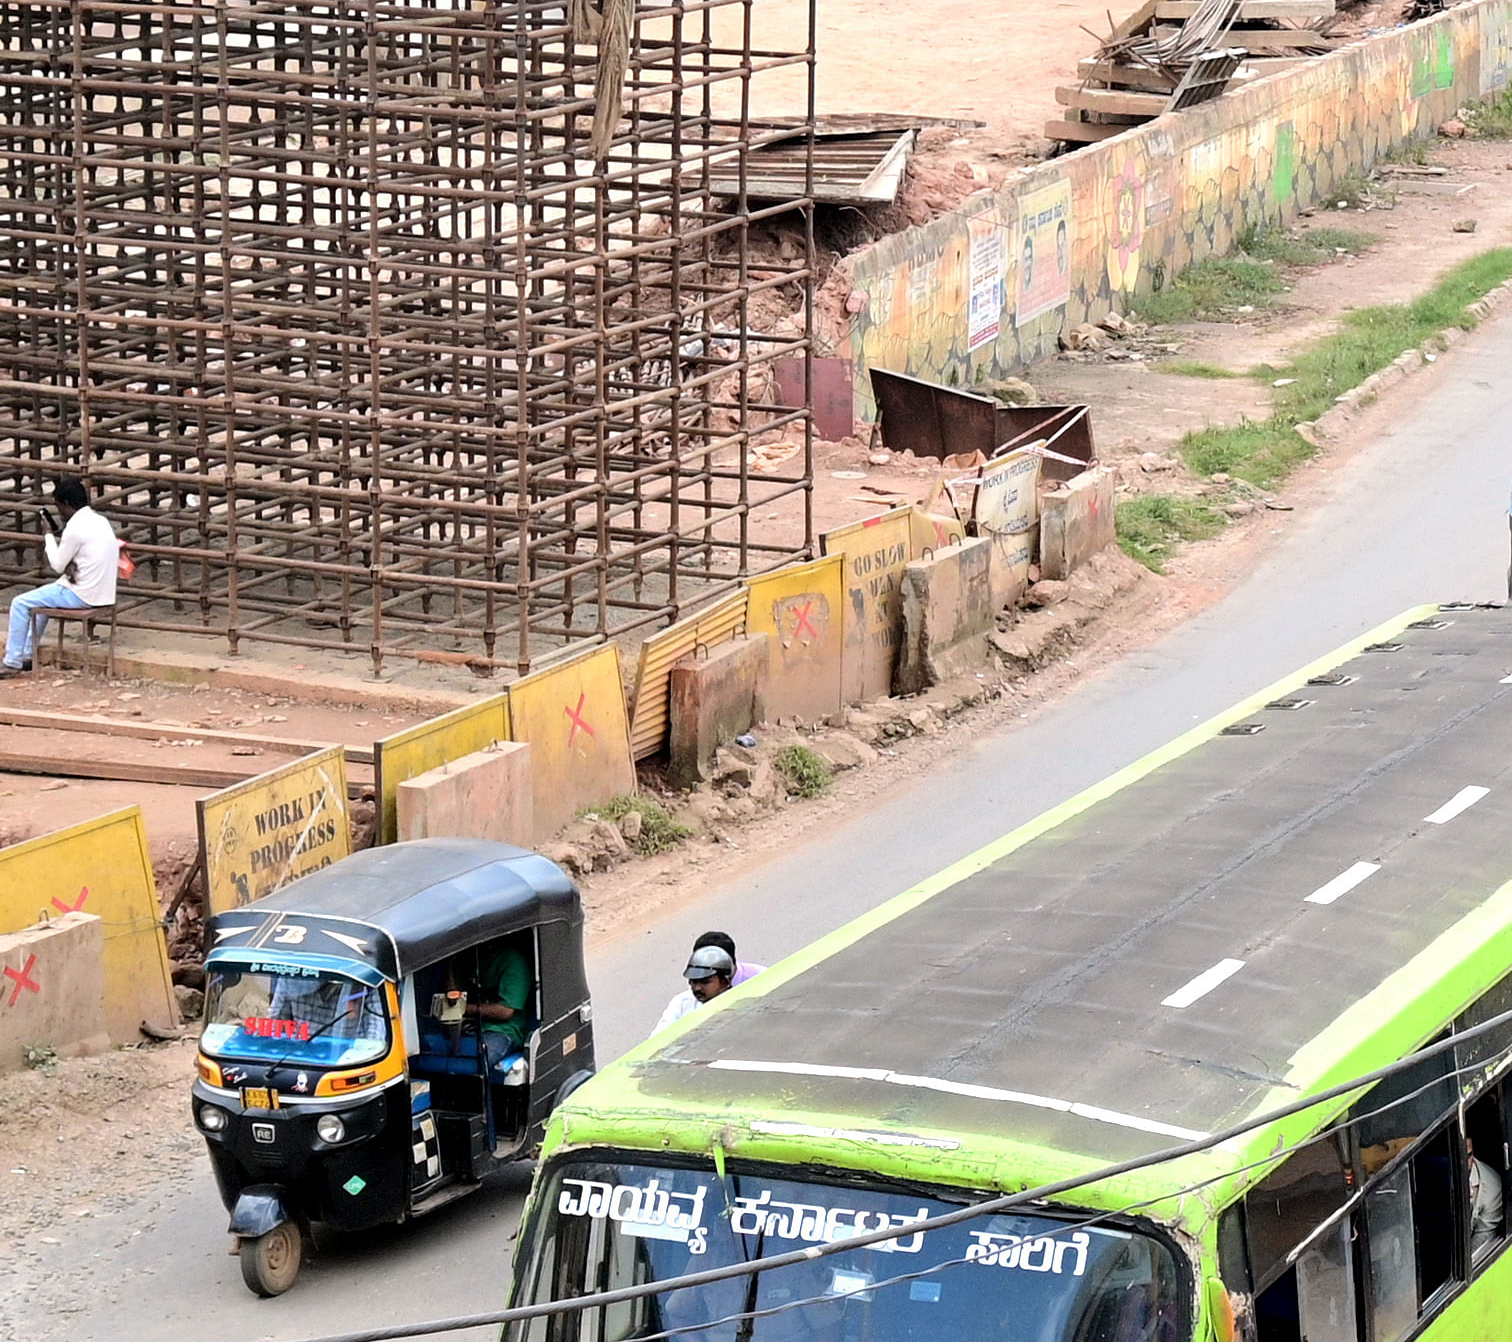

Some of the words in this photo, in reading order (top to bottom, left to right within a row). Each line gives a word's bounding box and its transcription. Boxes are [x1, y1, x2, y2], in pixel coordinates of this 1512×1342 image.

[255, 797, 304, 837] WORK
[250, 819, 335, 874] PROGRESS
[244, 1016, 310, 1041] SHIVA
[559, 1177, 707, 1254] ವಾಯವ್ಯ
[965, 1230, 1090, 1276] ಸಾರಿಗೆ
